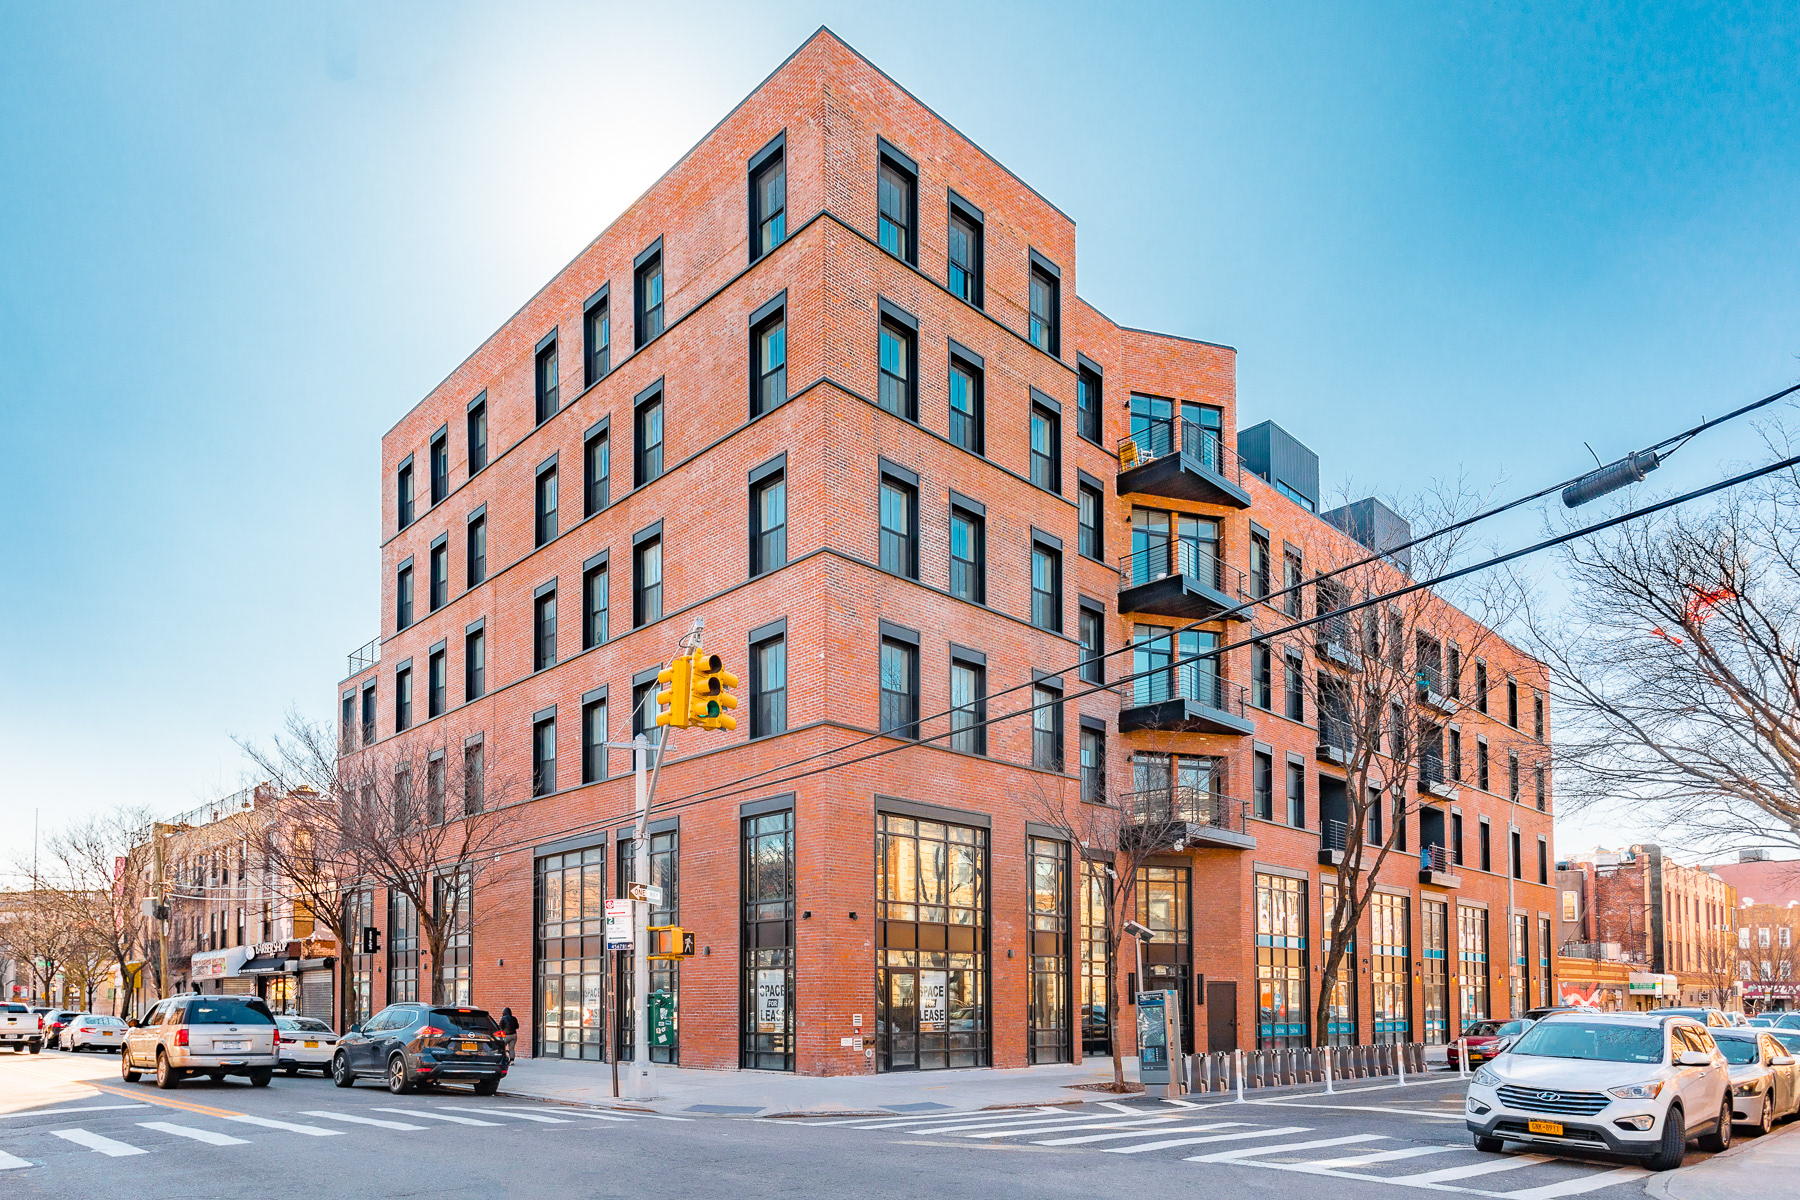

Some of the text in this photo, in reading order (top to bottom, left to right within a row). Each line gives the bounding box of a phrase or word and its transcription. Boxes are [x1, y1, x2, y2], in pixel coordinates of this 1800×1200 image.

[634, 888, 646, 897] ONE
[274, 941, 288, 953] SHOP
[760, 985, 785, 997] SPACE
[920, 986, 944, 997] SPACE
[920, 1010, 944, 1022] LEASE
